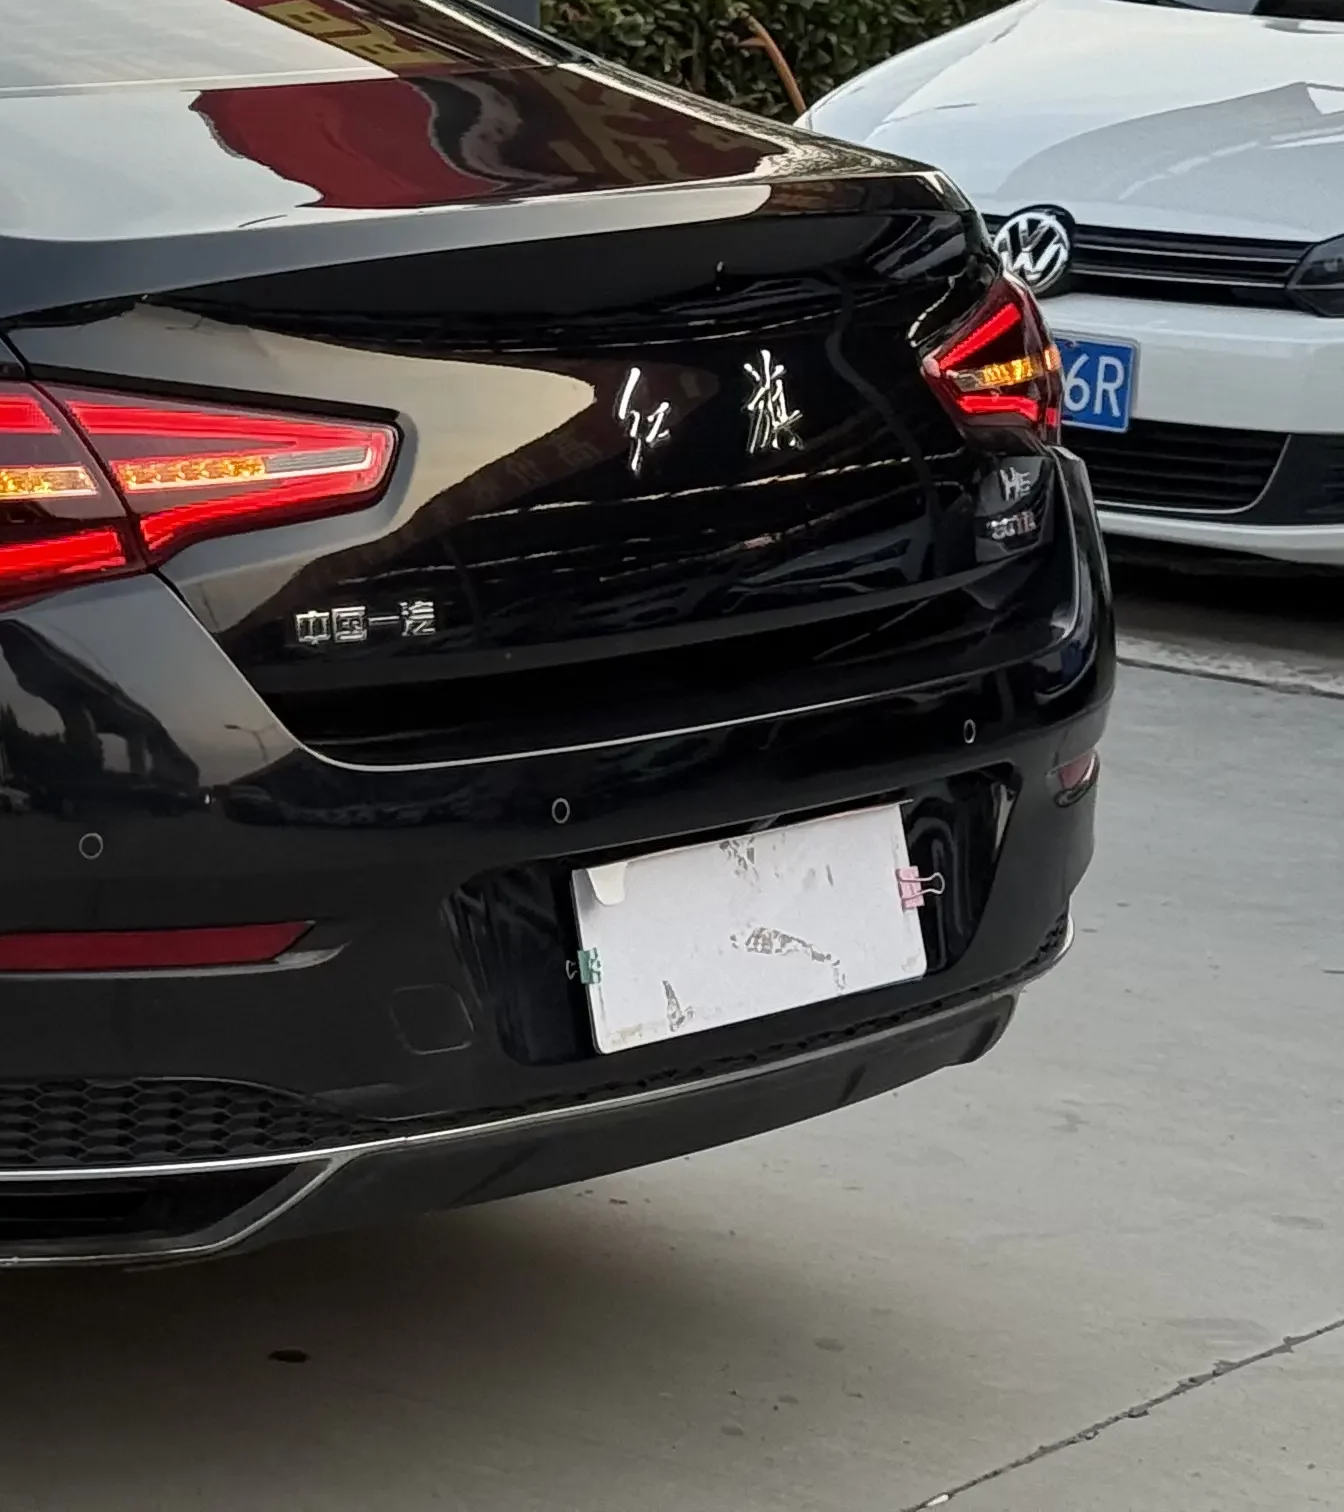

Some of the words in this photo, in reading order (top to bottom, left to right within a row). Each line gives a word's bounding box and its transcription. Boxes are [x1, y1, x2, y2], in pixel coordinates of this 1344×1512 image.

[999, 467, 1032, 502] H5
[295, 598, 436, 645] 中国一汽
